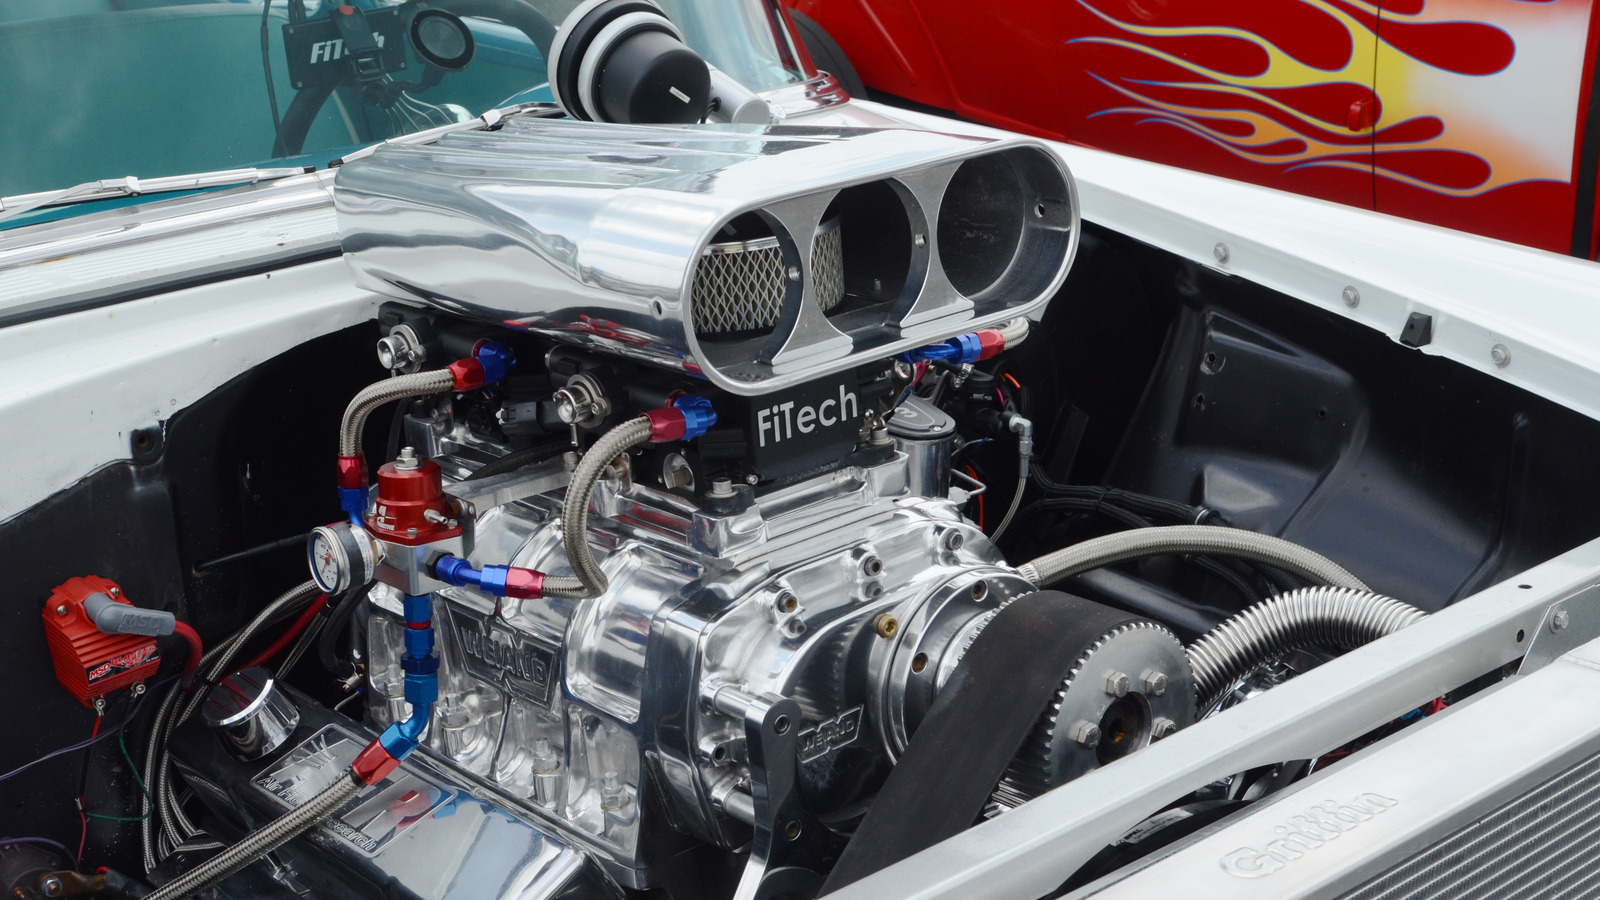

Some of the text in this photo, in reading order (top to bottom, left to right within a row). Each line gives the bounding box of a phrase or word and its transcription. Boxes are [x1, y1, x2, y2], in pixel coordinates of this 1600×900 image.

[310, 31, 385, 64] FiTh
[757, 384, 858, 447] FiTech
[122, 613, 160, 629] MSD
[89, 662, 112, 681] MSD
[460, 626, 548, 688] WEIAND
[799, 720, 855, 751] WEIAND
[257, 776, 283, 792] Air
[1218, 792, 1399, 880] Griffin
